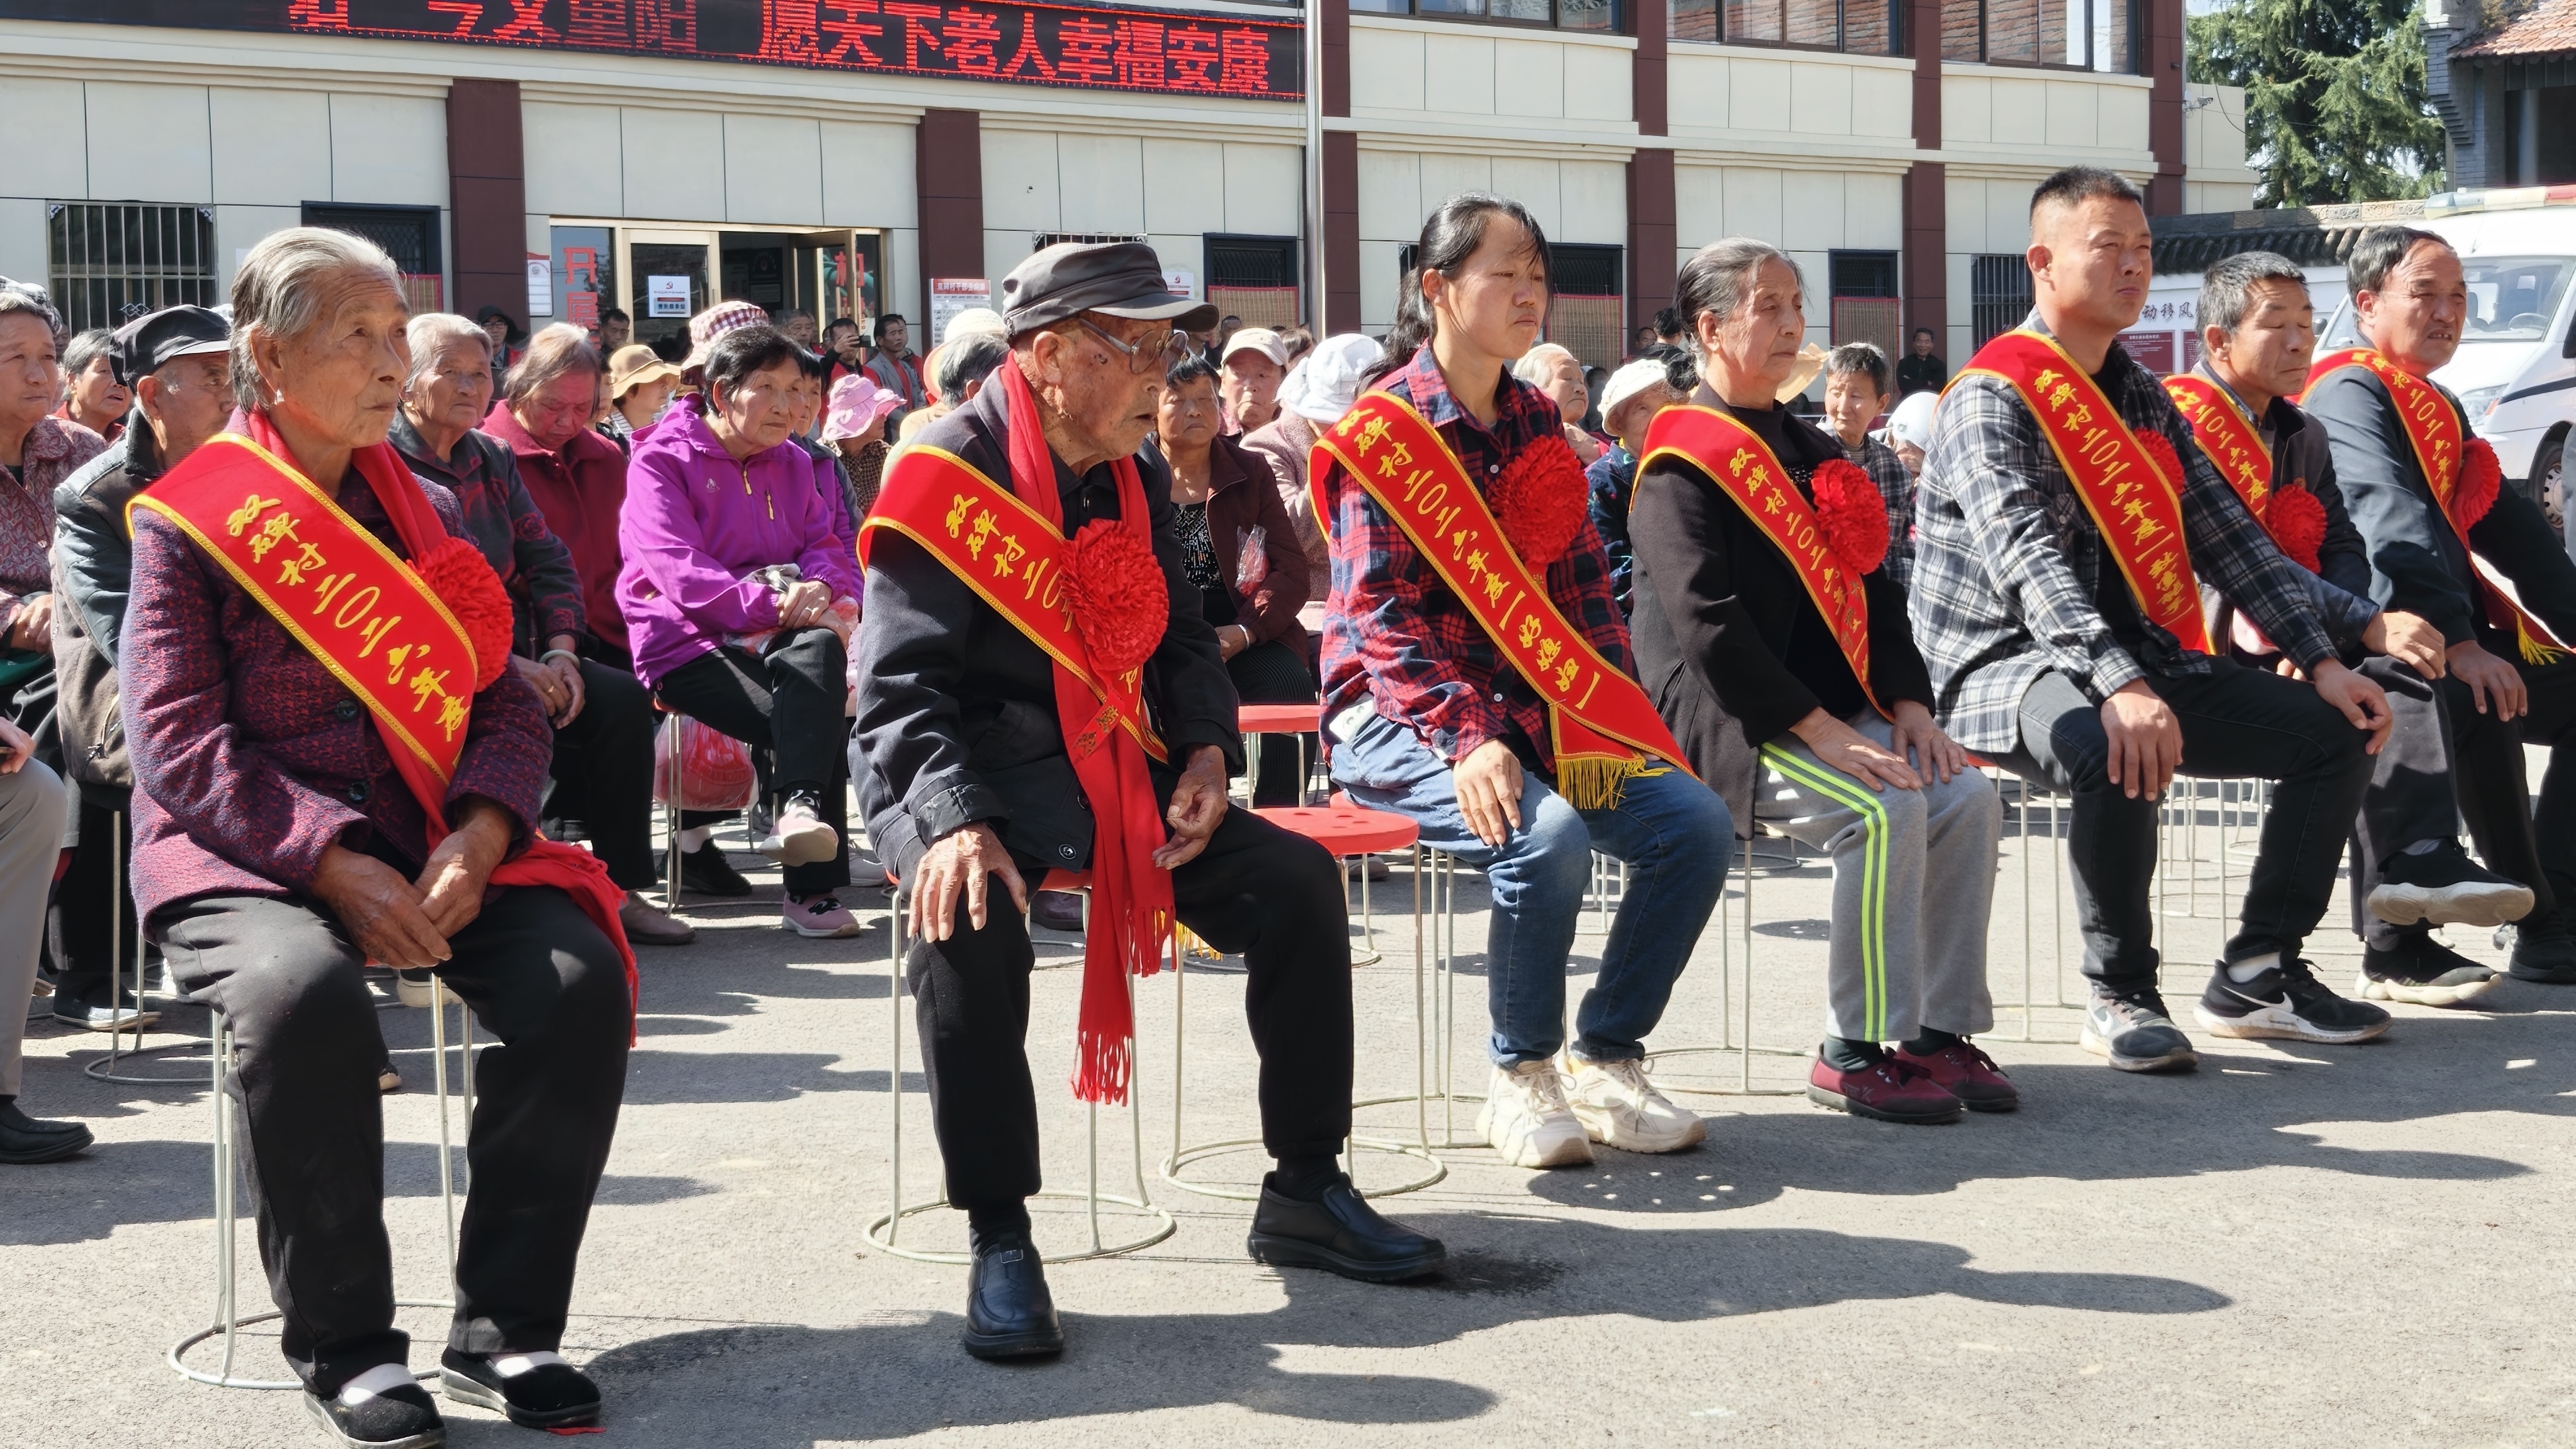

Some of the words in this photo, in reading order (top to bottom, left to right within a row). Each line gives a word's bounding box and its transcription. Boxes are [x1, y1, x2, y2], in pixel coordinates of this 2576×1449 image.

[759, 0, 1270, 91] 愿天下老人幸福安康
